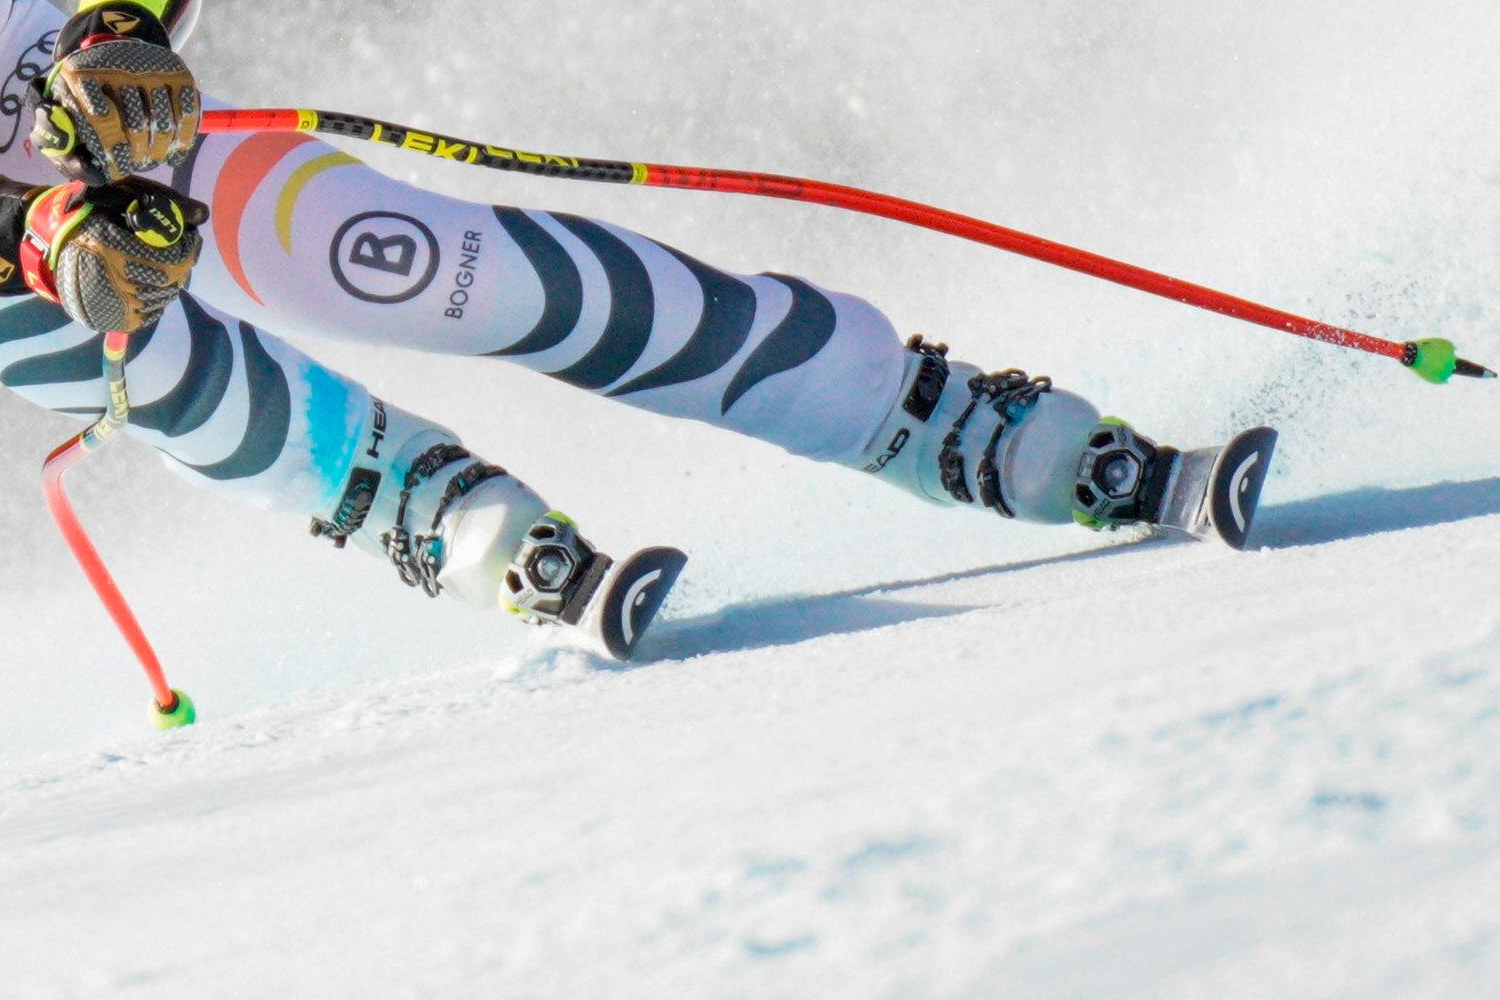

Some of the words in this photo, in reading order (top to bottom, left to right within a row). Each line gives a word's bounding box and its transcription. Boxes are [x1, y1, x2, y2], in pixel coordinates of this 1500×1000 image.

[372, 124, 478, 165] LEKI
[149, 207, 178, 234] LEKI
[349, 231, 417, 277] B
[445, 229, 483, 321] BOGNER
[366, 394, 387, 460] HEA
[863, 427, 910, 474] EAD
